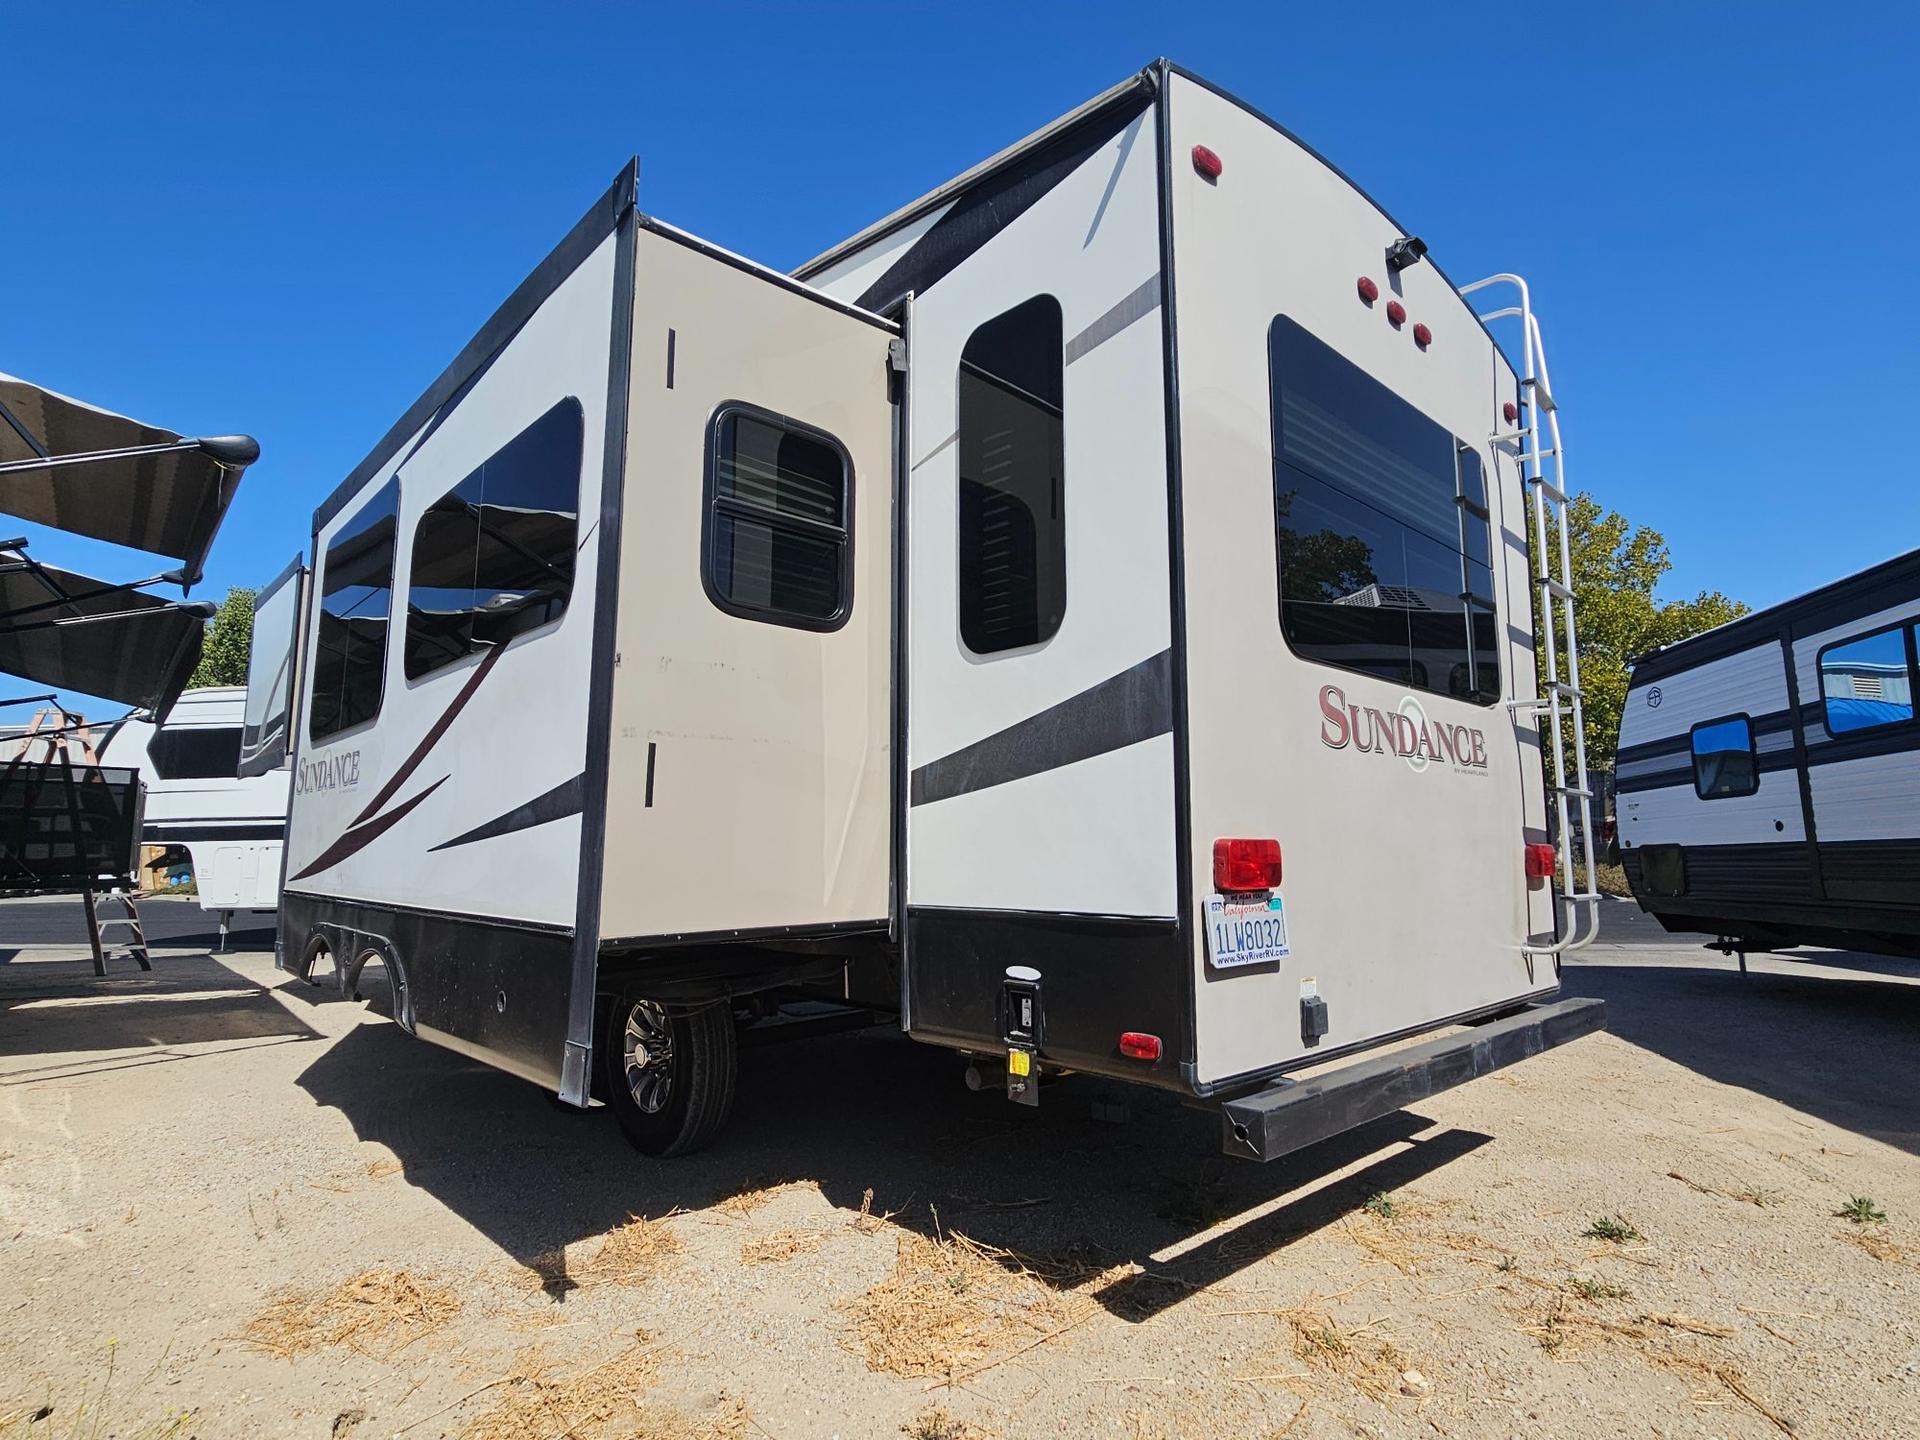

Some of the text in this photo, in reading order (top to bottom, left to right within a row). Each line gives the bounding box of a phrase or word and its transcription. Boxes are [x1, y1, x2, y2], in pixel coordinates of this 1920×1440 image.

[1319, 684, 1488, 768] SUNDANCE
[296, 750, 361, 795] SUNDANCE
[1216, 918, 1283, 955] 1LW8032
[1217, 949, 1290, 965] www.SkyRiverRV.com
